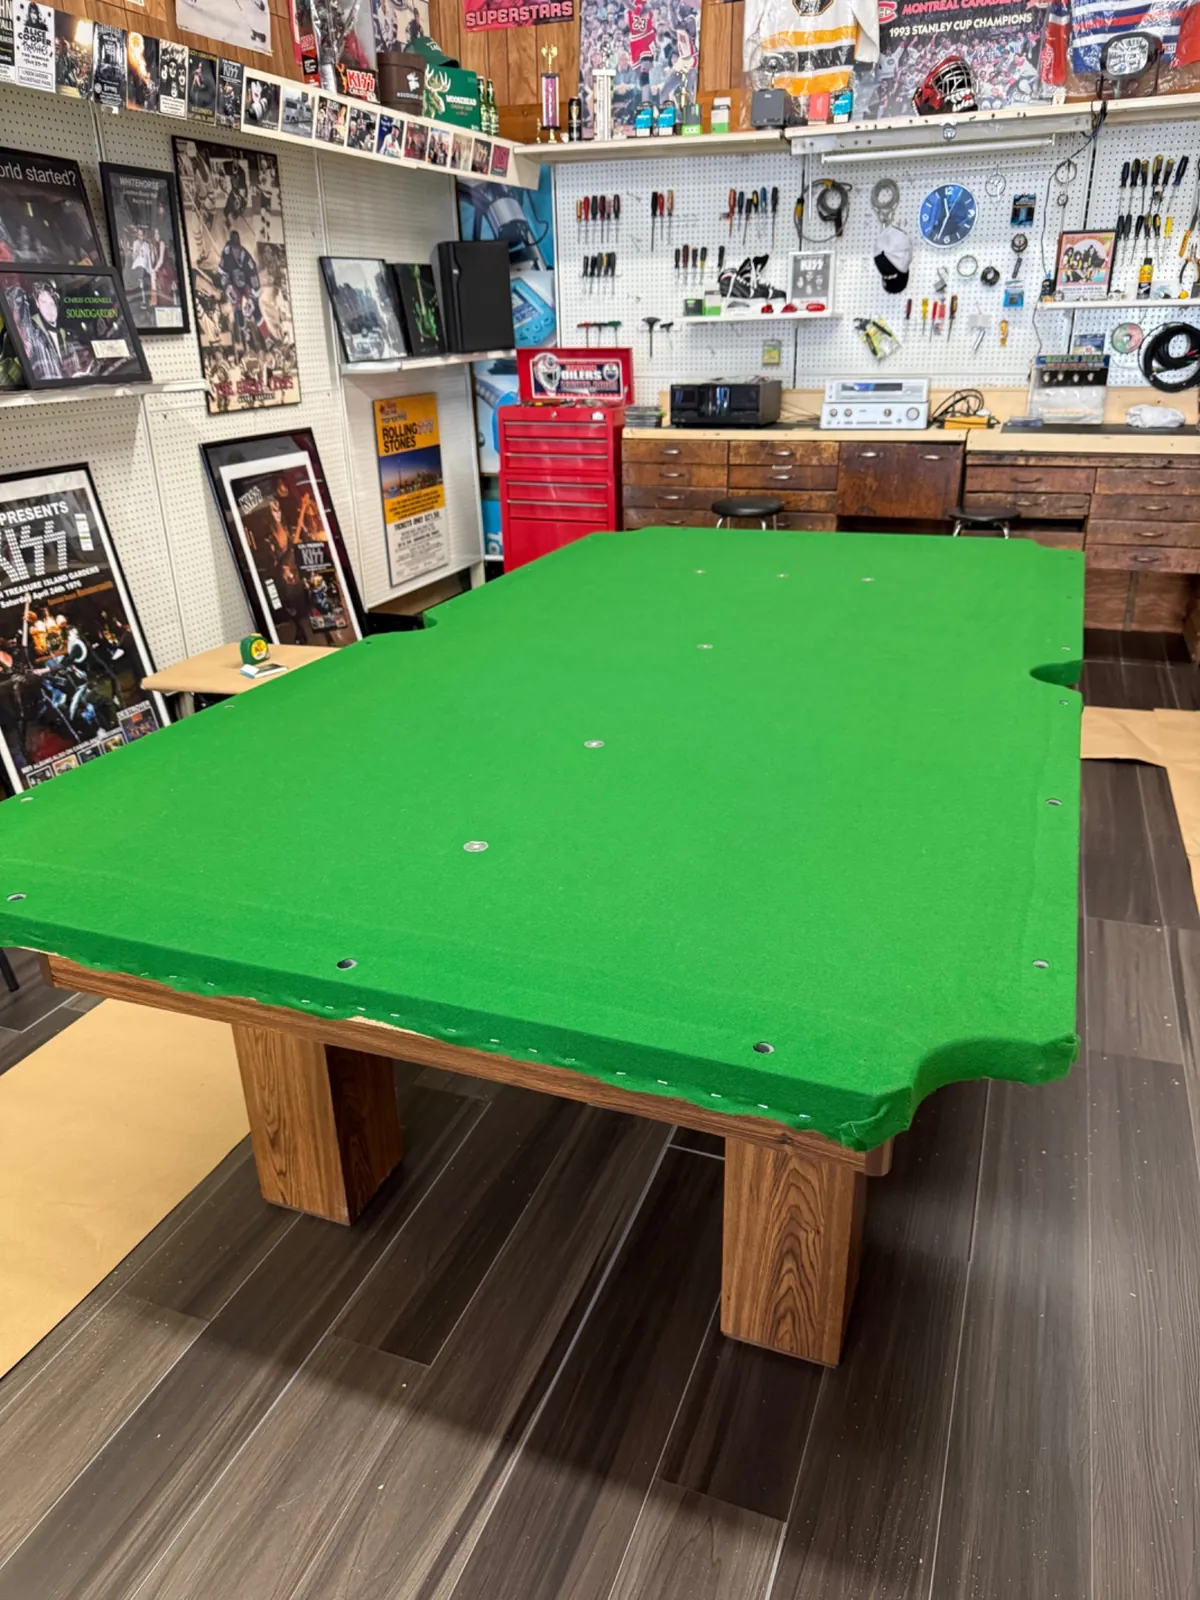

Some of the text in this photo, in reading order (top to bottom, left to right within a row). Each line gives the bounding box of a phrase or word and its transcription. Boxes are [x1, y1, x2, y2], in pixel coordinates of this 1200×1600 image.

[465, 3, 573, 27] SUPERSTARS
[632, 16, 648, 31] 23
[889, 13, 1033, 38] 1993 STANLEY CUP CHAMPIONS
[18, 32, 51, 46] COOPER
[23, 27, 46, 38] ALICE
[346, 68, 375, 91] KISS
[25, 168, 77, 187] started?
[119, 176, 160, 190] WHITEHORSE
[944, 187, 953, 196] 12
[922, 213, 930, 222] 9
[967, 208, 976, 218] 3
[943, 236, 951, 244] 6
[801, 258, 824, 272] KISS
[66, 308, 118, 319] SOUNDGARDEN
[561, 370, 602, 381] OILERS
[382, 422, 418, 440] ROLLING
[383, 436, 417, 453] STONES
[0, 501, 69, 526] PRESENTS
[301, 549, 324, 566] KISS
[4, 581, 43, 598] TREASURE
[43, 574, 69, 586] ISLAND
[68, 566, 100, 580] GARDENS
[33, 589, 49, 600] April
[50, 584, 66, 595] 24th
